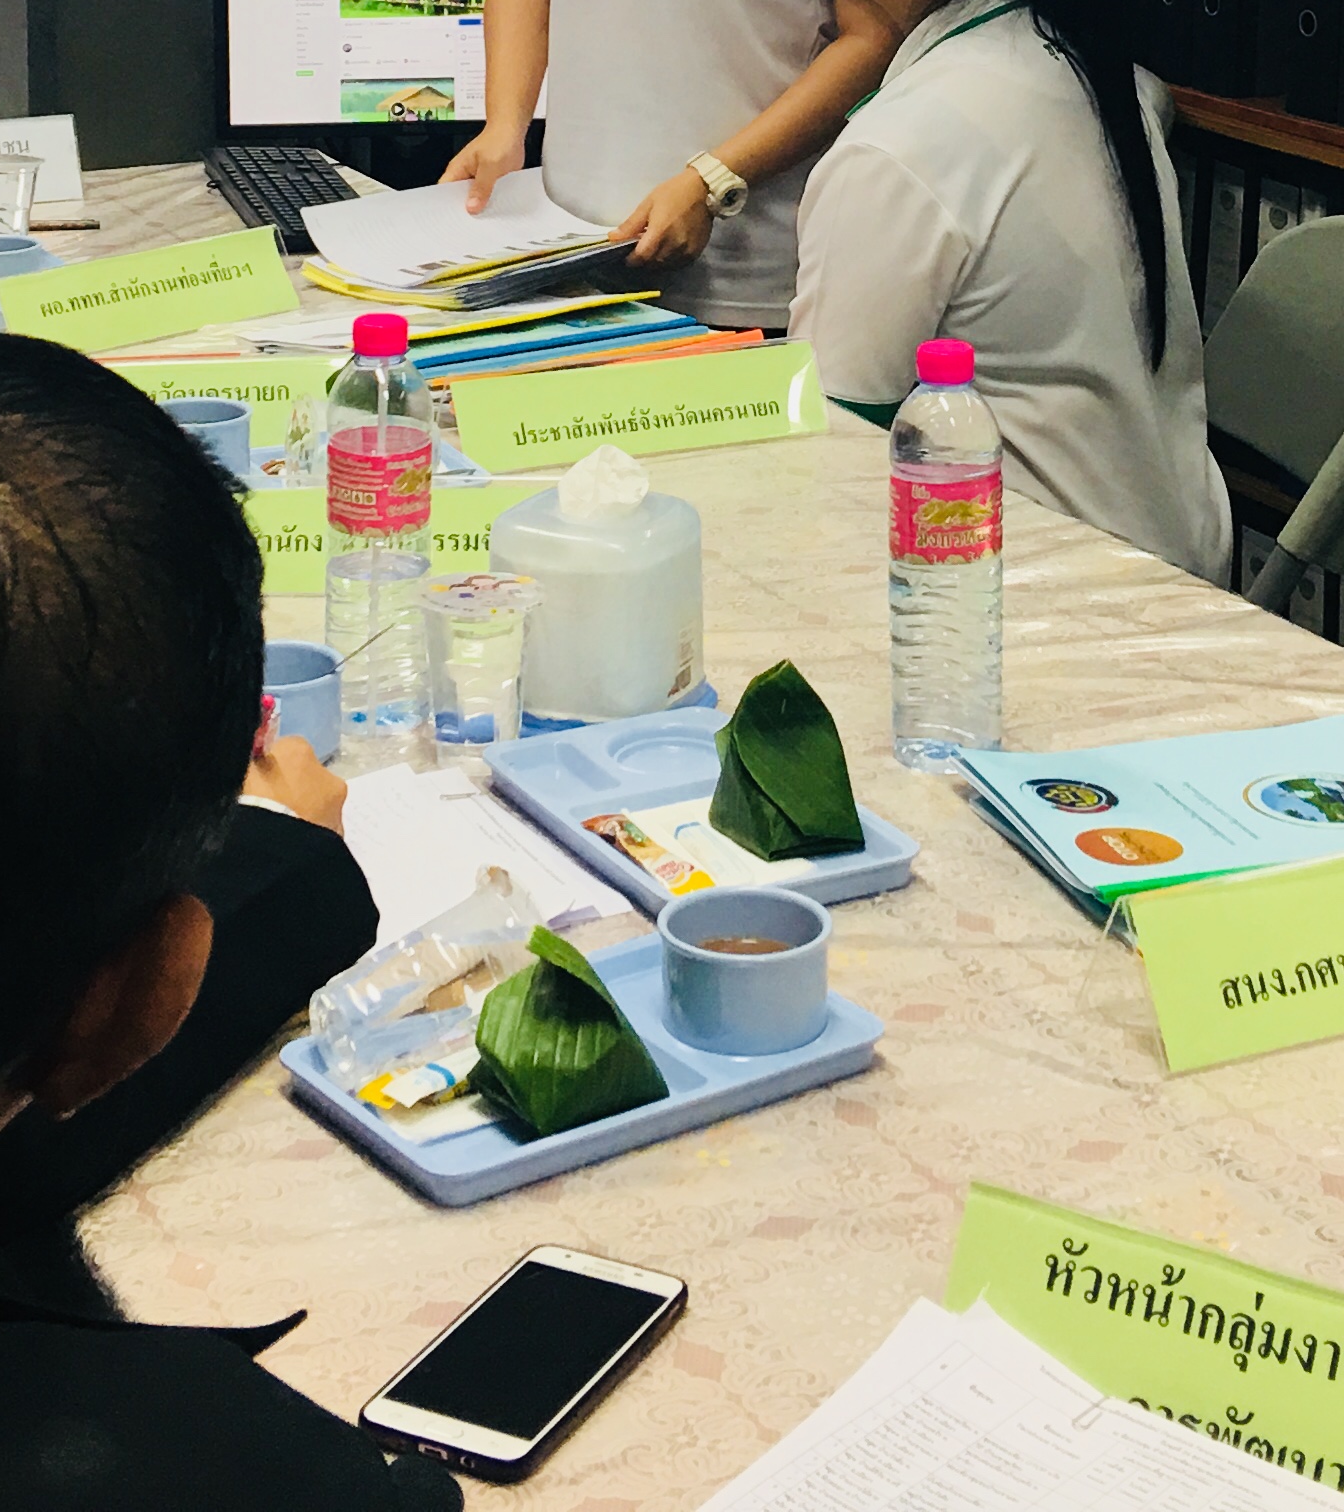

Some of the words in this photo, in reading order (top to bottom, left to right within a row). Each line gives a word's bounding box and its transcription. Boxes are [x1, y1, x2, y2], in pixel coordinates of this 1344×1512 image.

[512, 399, 780, 446] ประชาสัมพันธ์จังหวัดนครนายก
